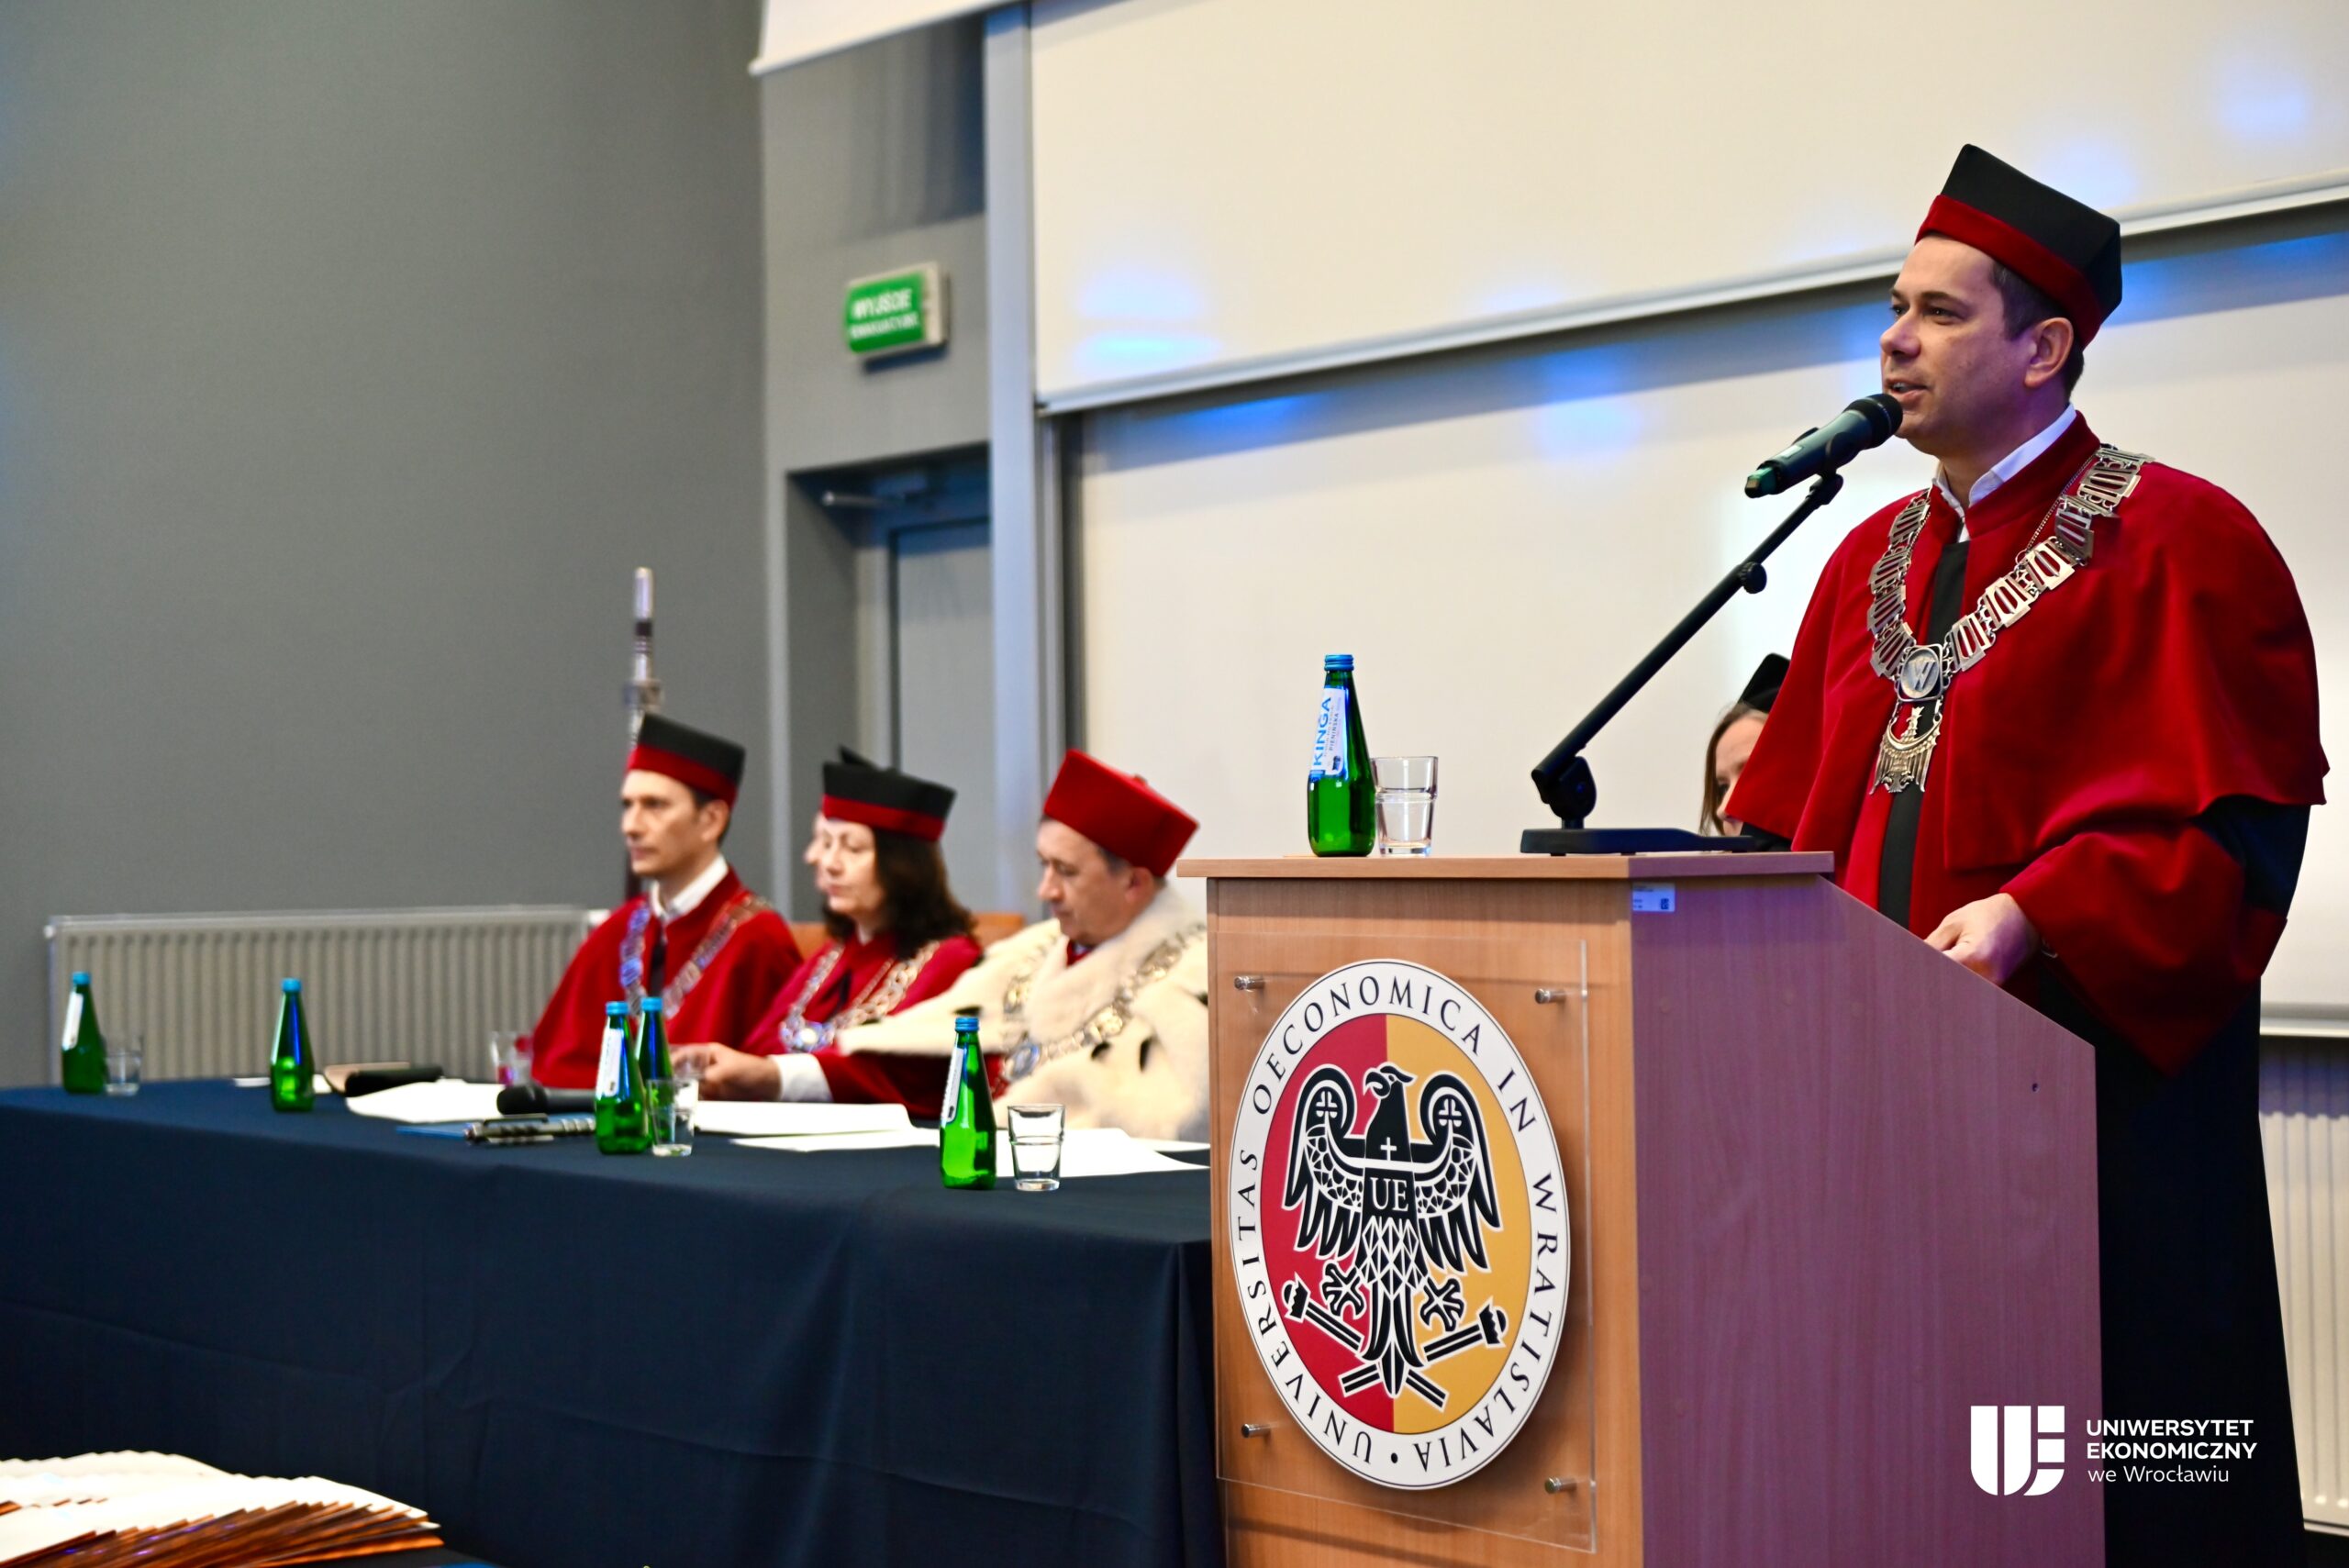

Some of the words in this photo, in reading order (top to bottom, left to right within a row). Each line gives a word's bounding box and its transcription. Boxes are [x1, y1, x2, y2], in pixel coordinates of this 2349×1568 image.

[1313, 697, 1331, 766] KINGA
[1253, 975, 1483, 1116] OECONOMICA
[1497, 1067, 1536, 1132] IN
[1370, 1176, 1409, 1212] UE
[1237, 1149, 1373, 1464] UNIVERSITAS
[1413, 1173, 1559, 1472] WRATISLAVIA
